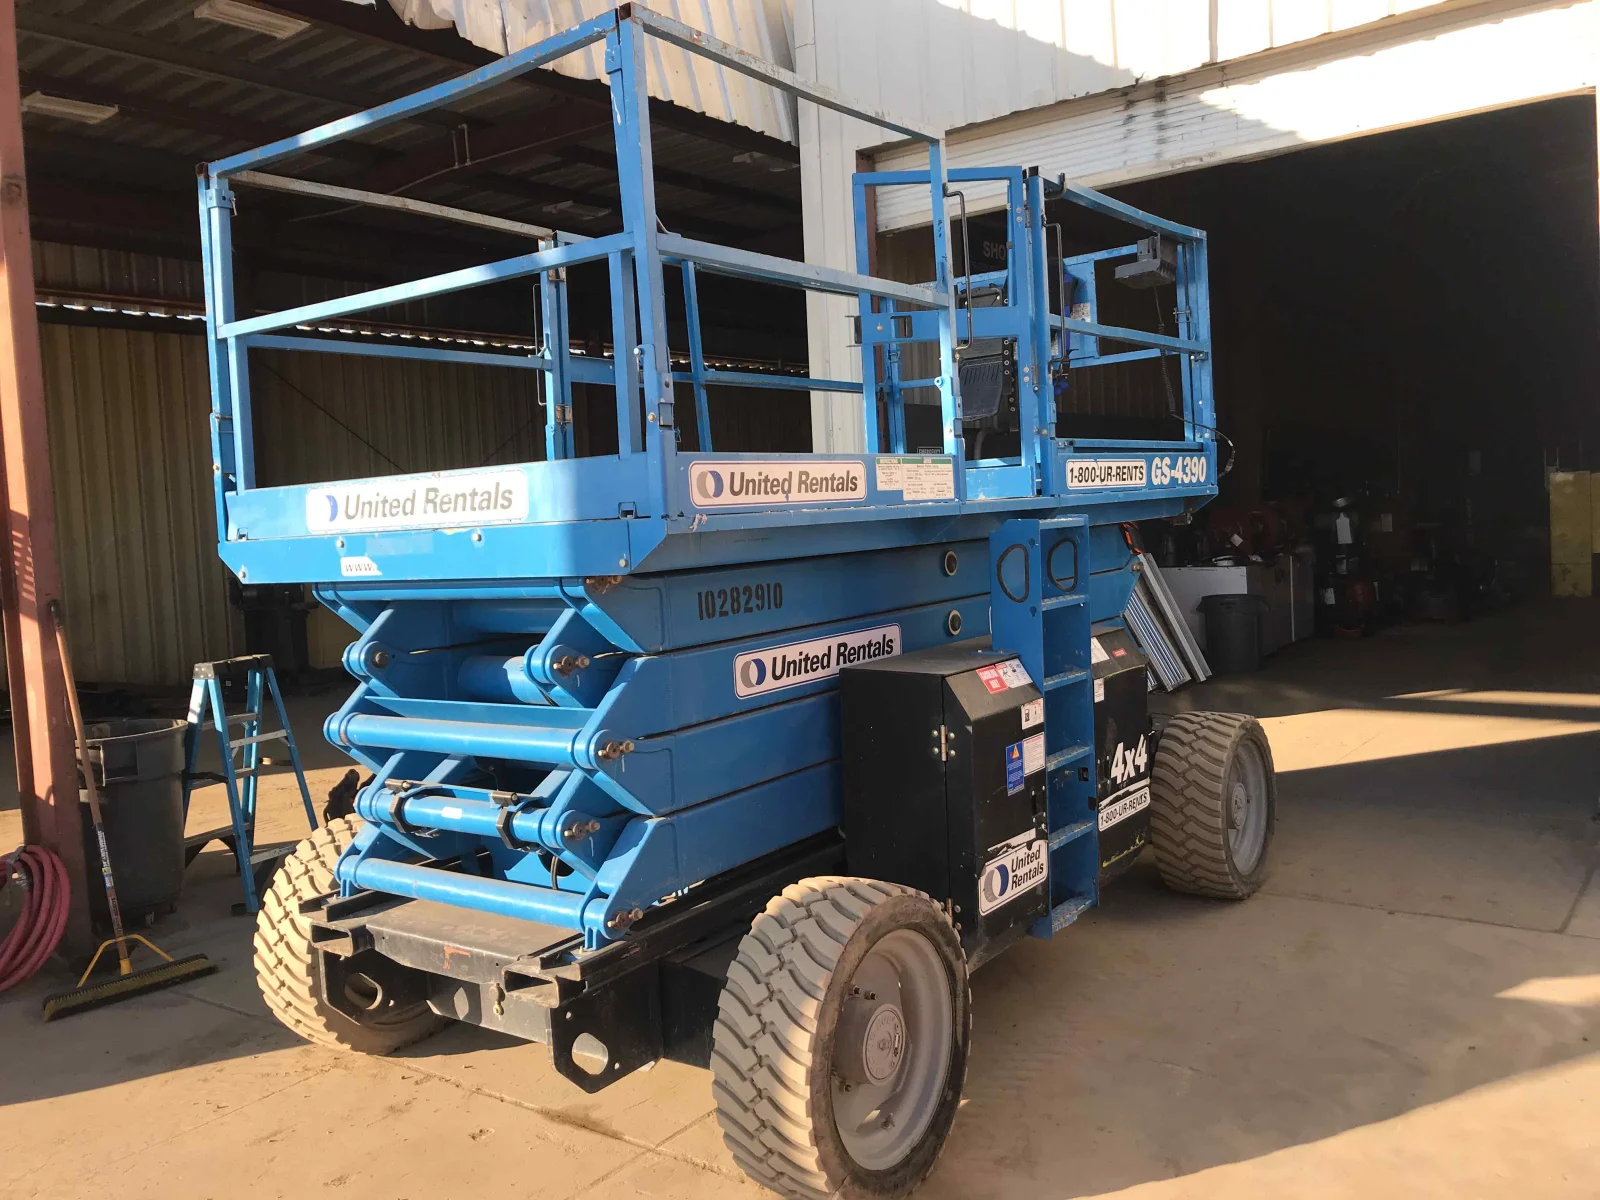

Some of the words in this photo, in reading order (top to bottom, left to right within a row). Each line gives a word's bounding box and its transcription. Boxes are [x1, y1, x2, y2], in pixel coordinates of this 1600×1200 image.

[729, 471, 792, 497] United
[797, 470, 858, 494] Rentals
[1069, 465, 1144, 483] 1-800-UR-RENTS
[1151, 456, 1207, 486] GS-4390
[344, 489, 417, 520] United
[423, 482, 513, 514] Rentals
[697, 582, 783, 620] 10282910
[771, 645, 832, 681] United
[836, 634, 894, 666] Rentals
[1110, 733, 1148, 785] 4x4
[1100, 791, 1148, 826] 1-800-UR-RENTS
[1011, 844, 1041, 873] United
[1010, 861, 1044, 890] Rentals
